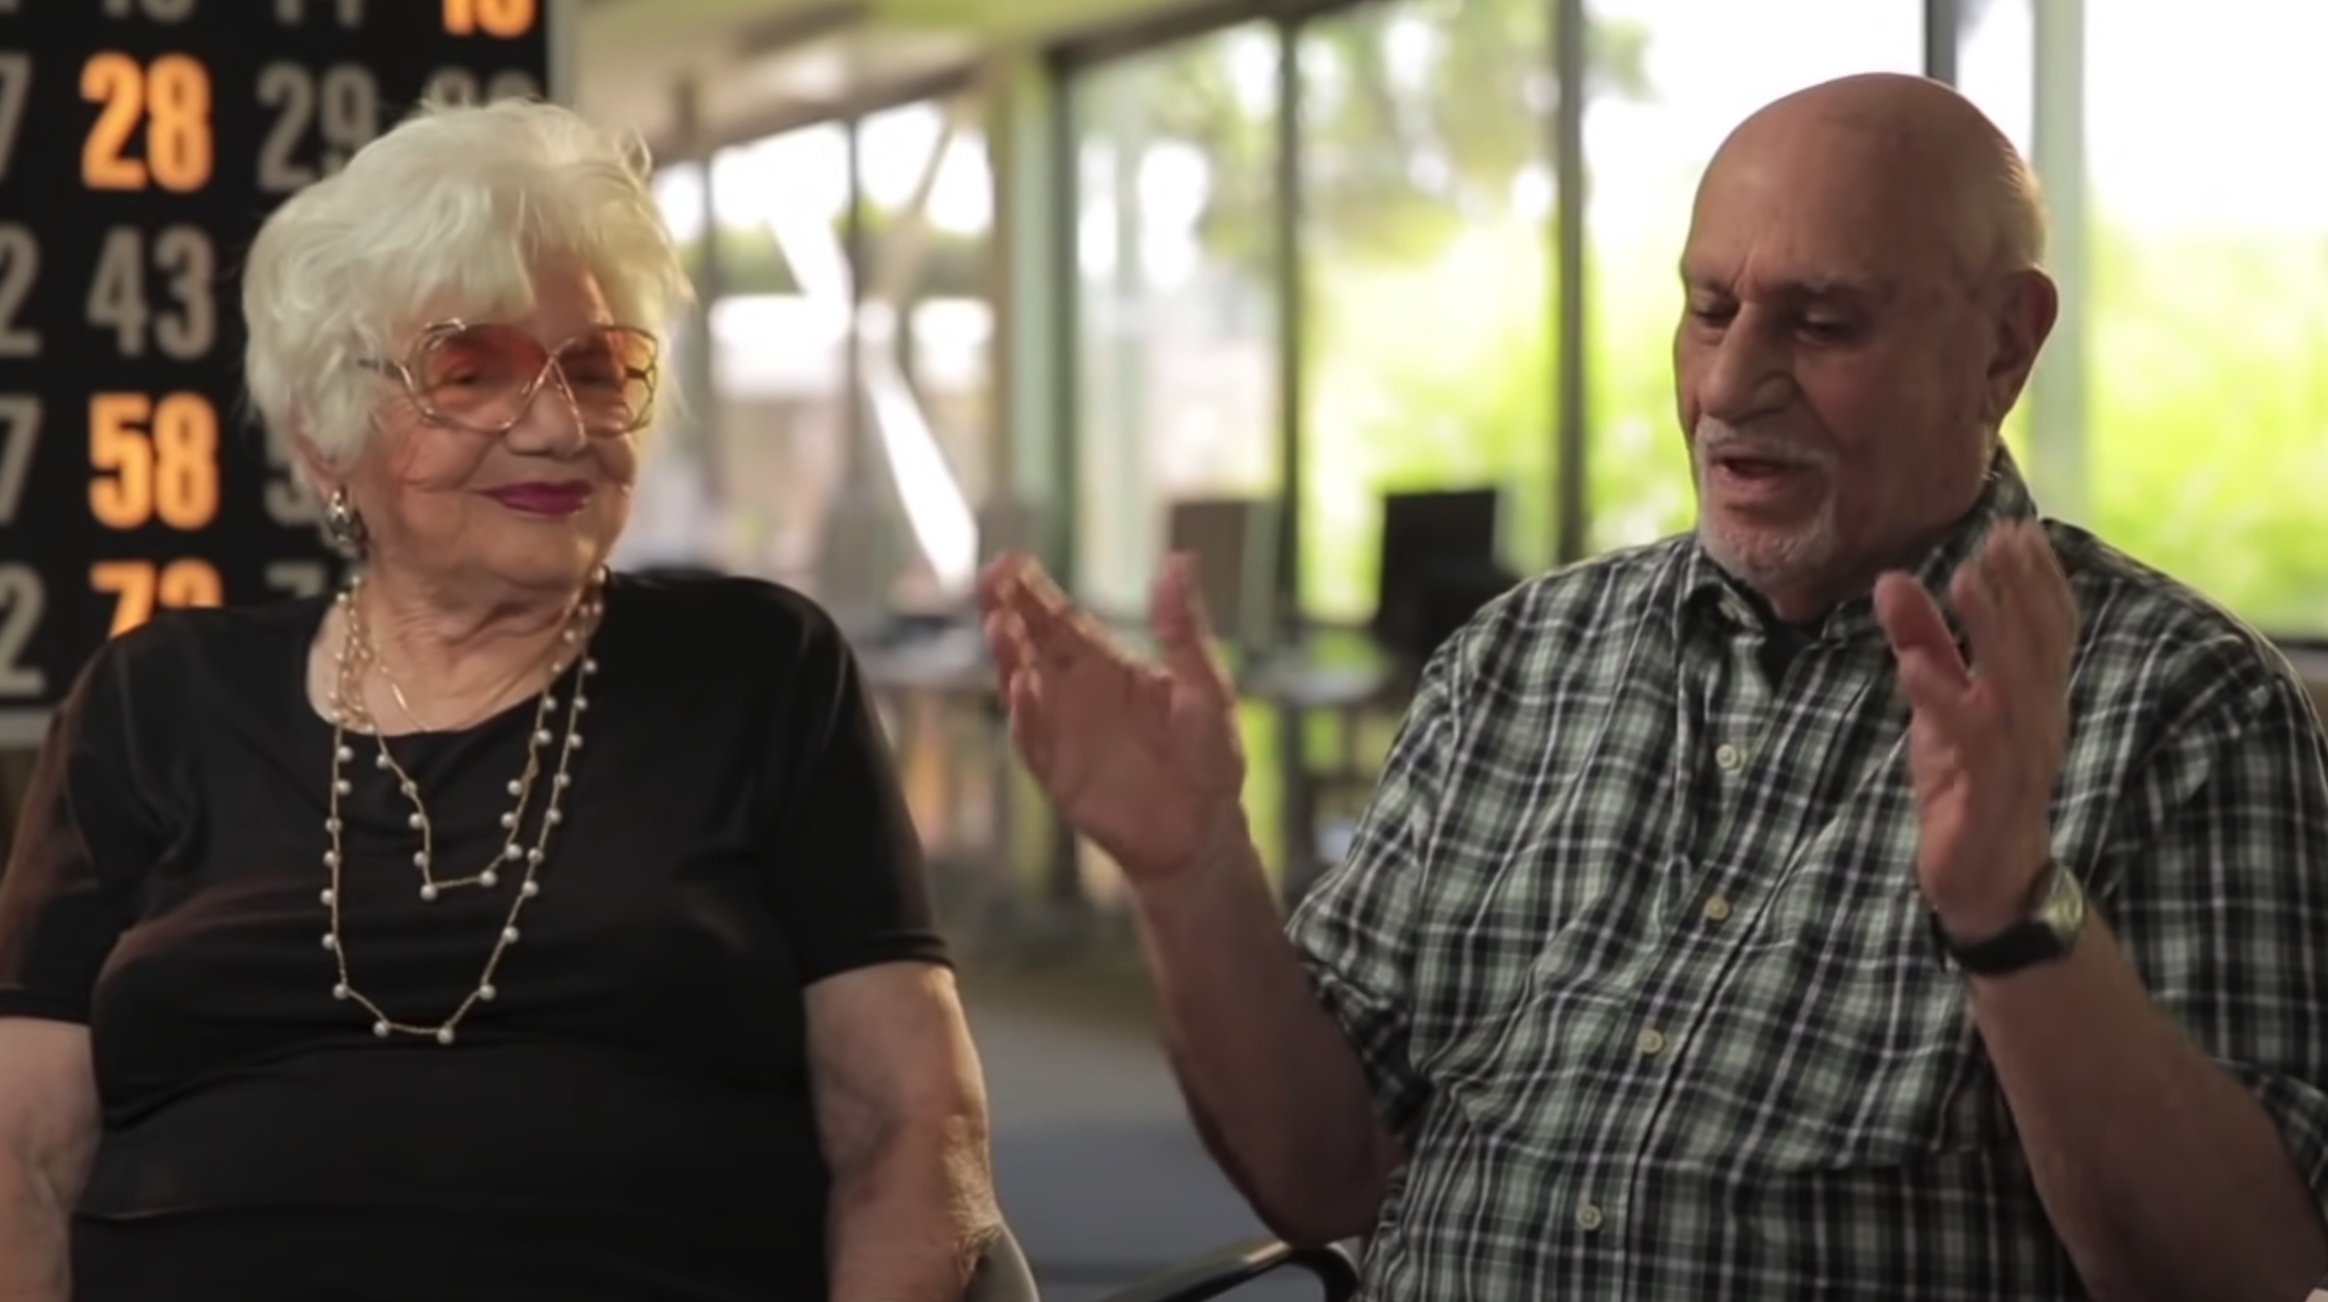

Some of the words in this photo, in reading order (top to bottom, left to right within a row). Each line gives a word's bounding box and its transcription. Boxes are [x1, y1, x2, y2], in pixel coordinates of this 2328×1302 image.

[81, 52, 212, 191] 28
[257, 63, 379, 191] 29
[86, 225, 216, 359] 43
[89, 392, 219, 529] 58
